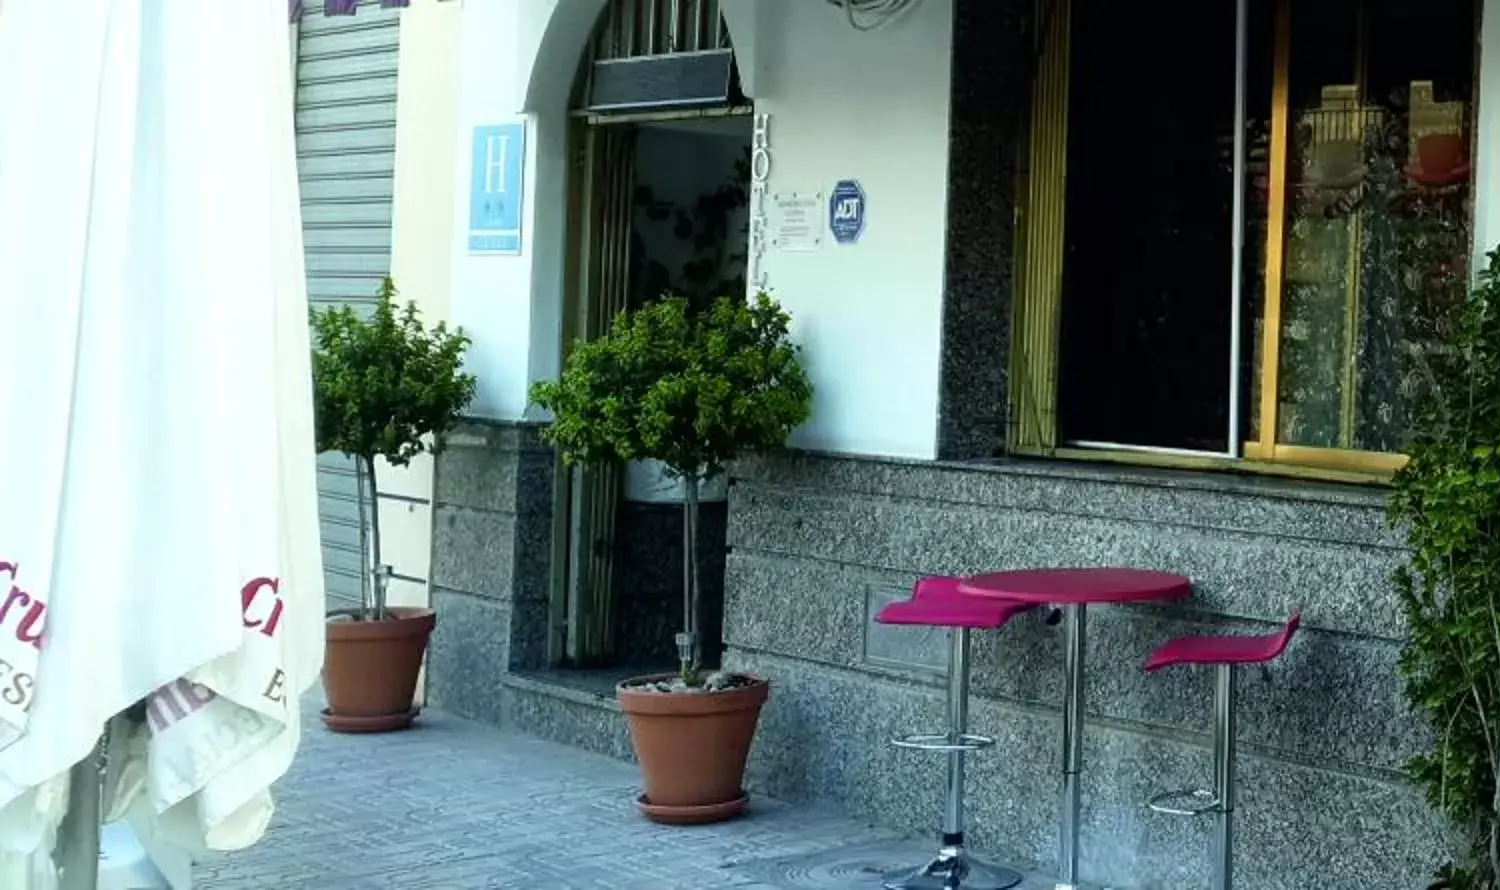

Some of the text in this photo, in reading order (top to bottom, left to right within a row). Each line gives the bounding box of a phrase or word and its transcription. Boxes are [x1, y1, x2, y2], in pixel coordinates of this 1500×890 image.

[484, 135, 511, 193] H
[750, 113, 770, 290] HOTEL
[835, 198, 860, 220] ADT
